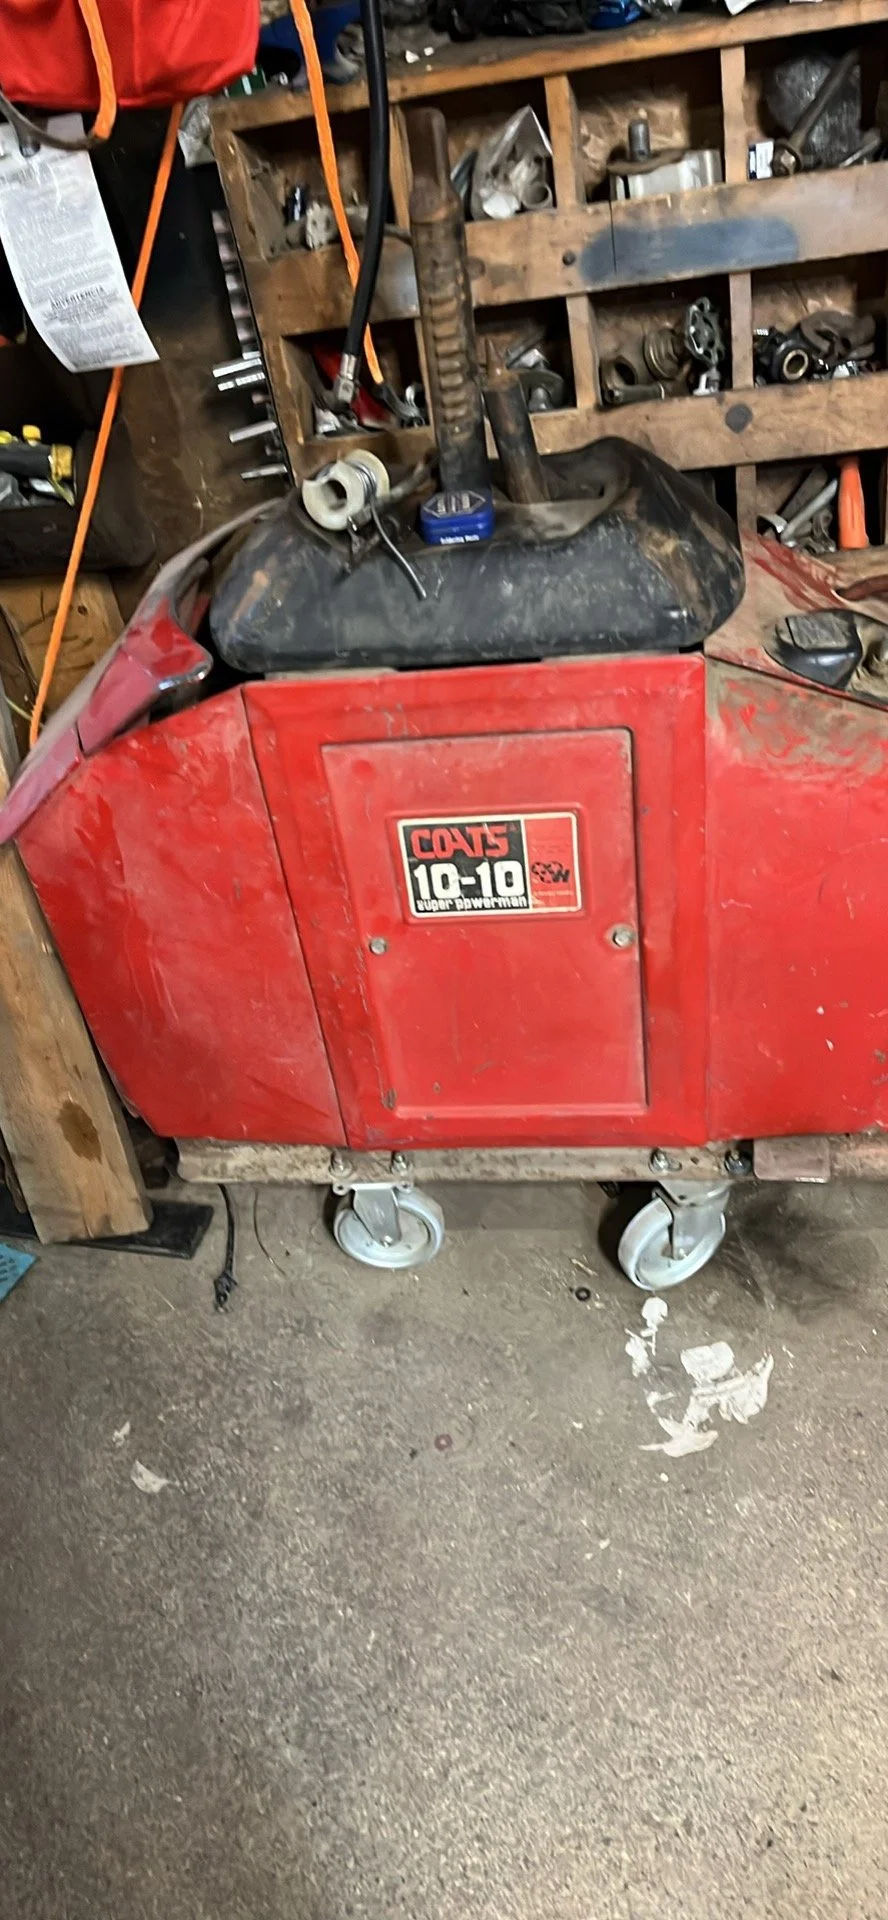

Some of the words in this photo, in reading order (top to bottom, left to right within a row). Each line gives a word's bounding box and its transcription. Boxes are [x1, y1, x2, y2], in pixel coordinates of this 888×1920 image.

[410, 824, 509, 859] COATS
[413, 860, 525, 901] 10-10
[416, 899, 453, 912] super
[455, 896, 528, 911] powerman
